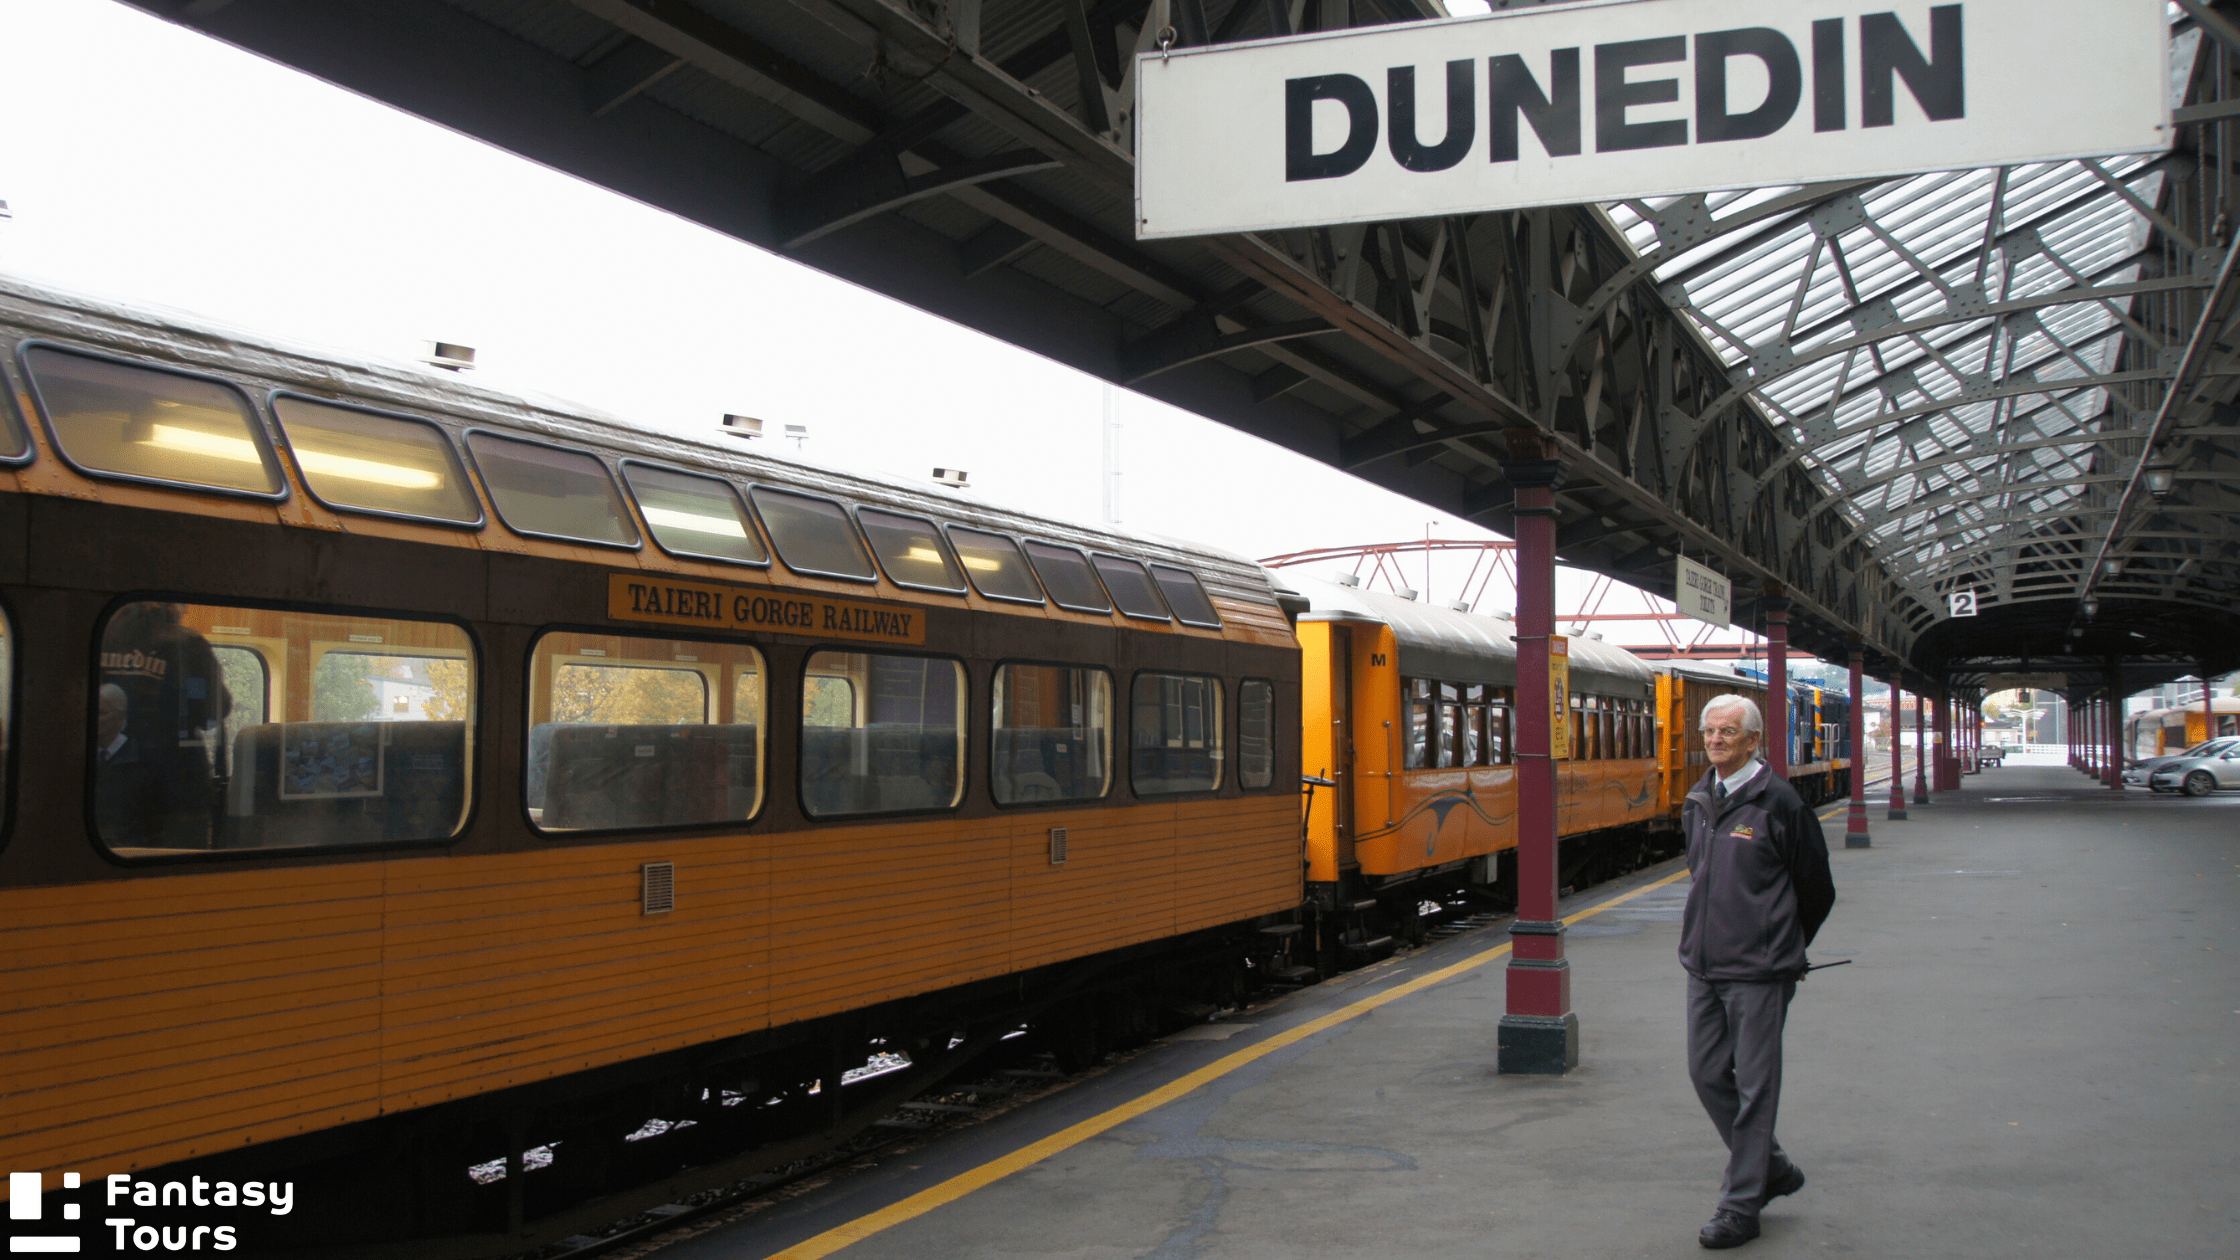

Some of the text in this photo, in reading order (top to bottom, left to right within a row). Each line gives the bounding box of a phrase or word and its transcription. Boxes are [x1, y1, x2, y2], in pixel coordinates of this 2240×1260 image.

[1286, 4, 1964, 183] DUNEDIN
[628, 583, 912, 637] TAIERI GORGE RAILWAY
[1954, 594, 1973, 615] 2
[1371, 653, 1387, 667] M
